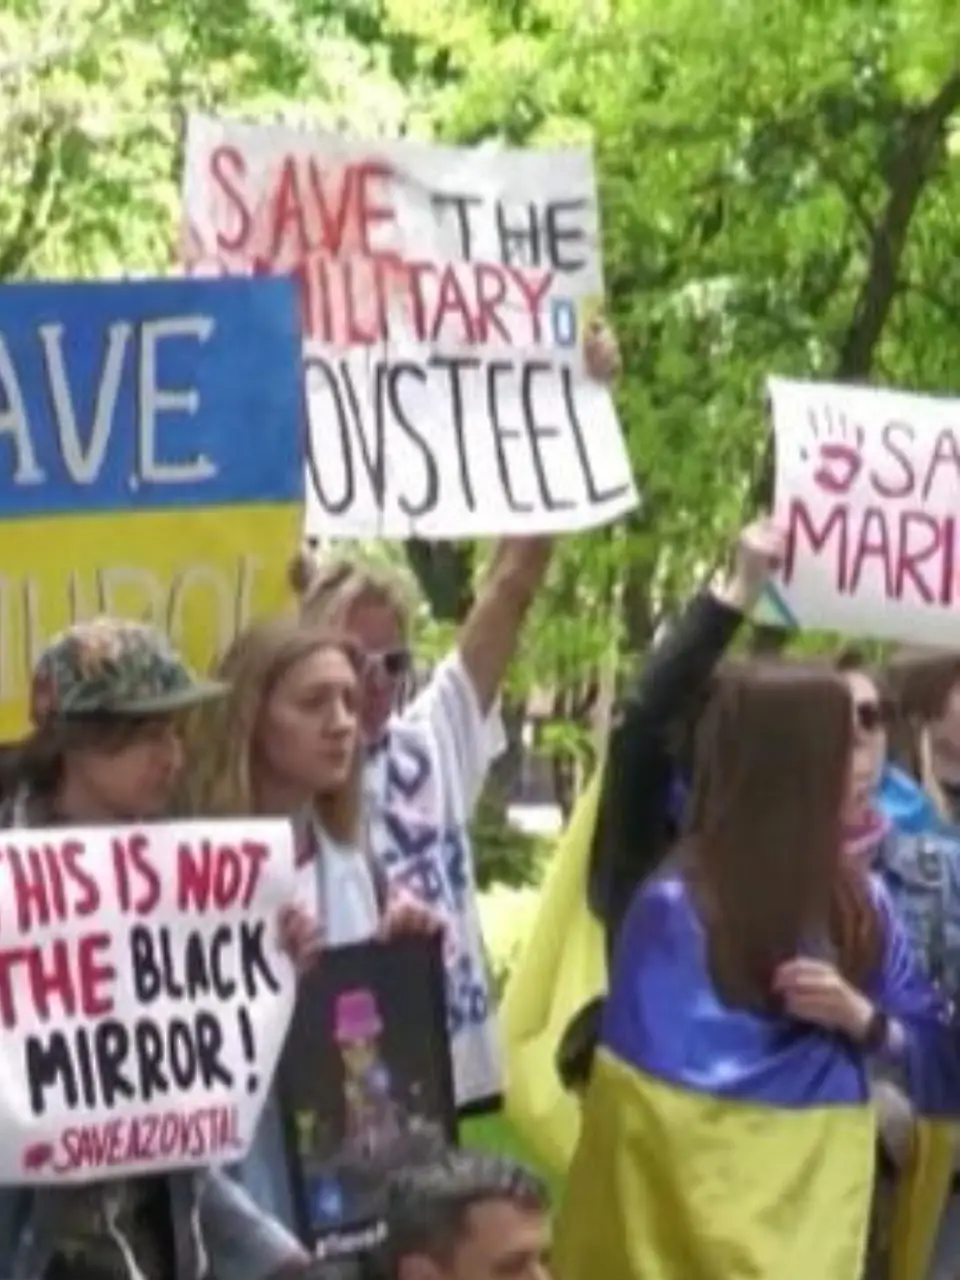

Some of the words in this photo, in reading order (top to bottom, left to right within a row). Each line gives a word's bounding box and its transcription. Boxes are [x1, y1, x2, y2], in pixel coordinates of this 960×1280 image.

[210, 145, 398, 262] SAVE
[432, 192, 588, 272] THE
[784, 496, 955, 606] MARI
[112, 833, 161, 917] IS
[177, 841, 270, 914] NOT
[130, 921, 280, 1001] BLACK
